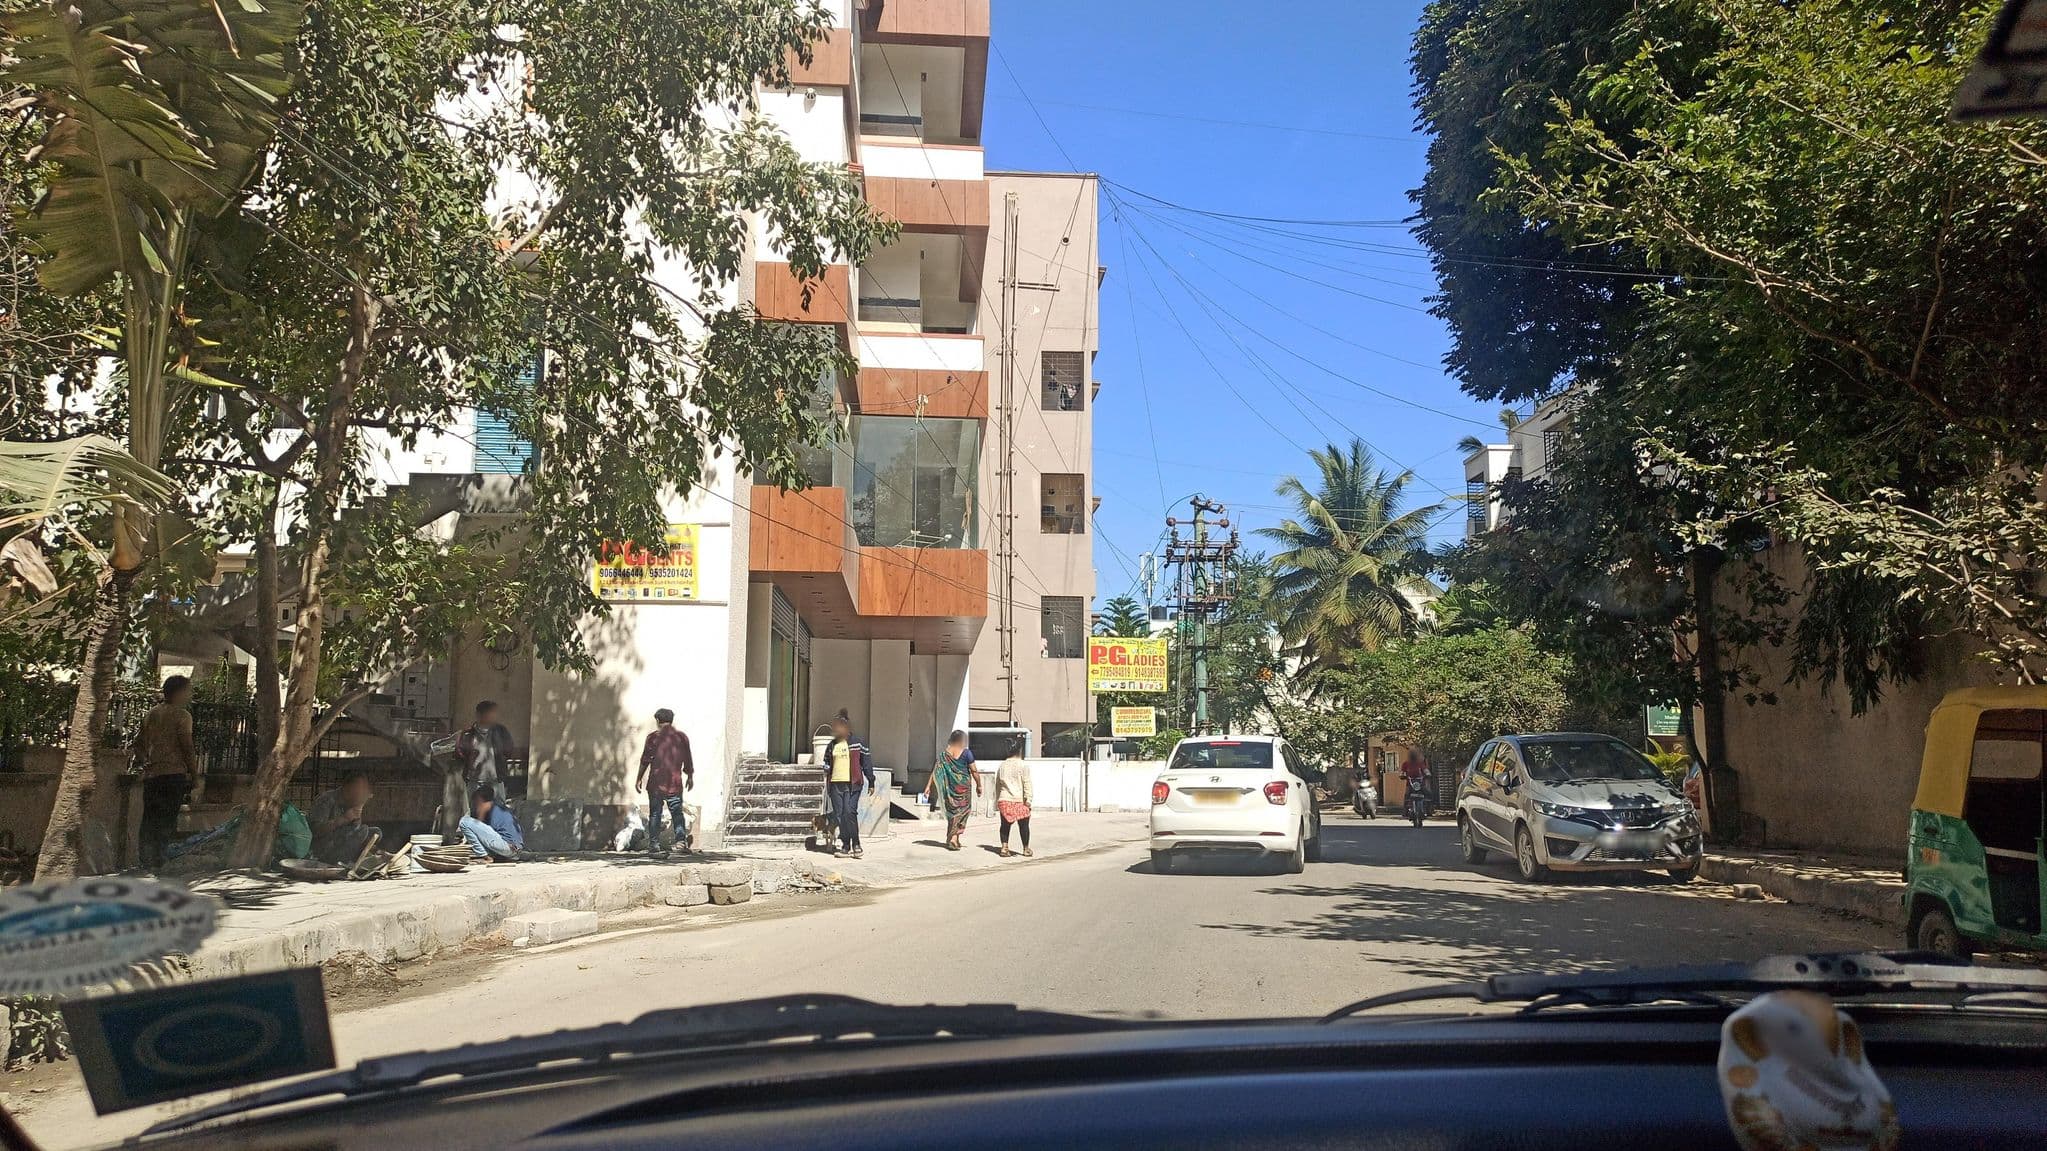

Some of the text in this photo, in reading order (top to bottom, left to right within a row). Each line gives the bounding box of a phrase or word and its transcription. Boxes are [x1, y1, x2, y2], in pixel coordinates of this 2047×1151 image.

[649, 568, 693, 578] 9535201424
[1090, 646, 1126, 666] PG
[1127, 655, 1166, 666] LADIES
